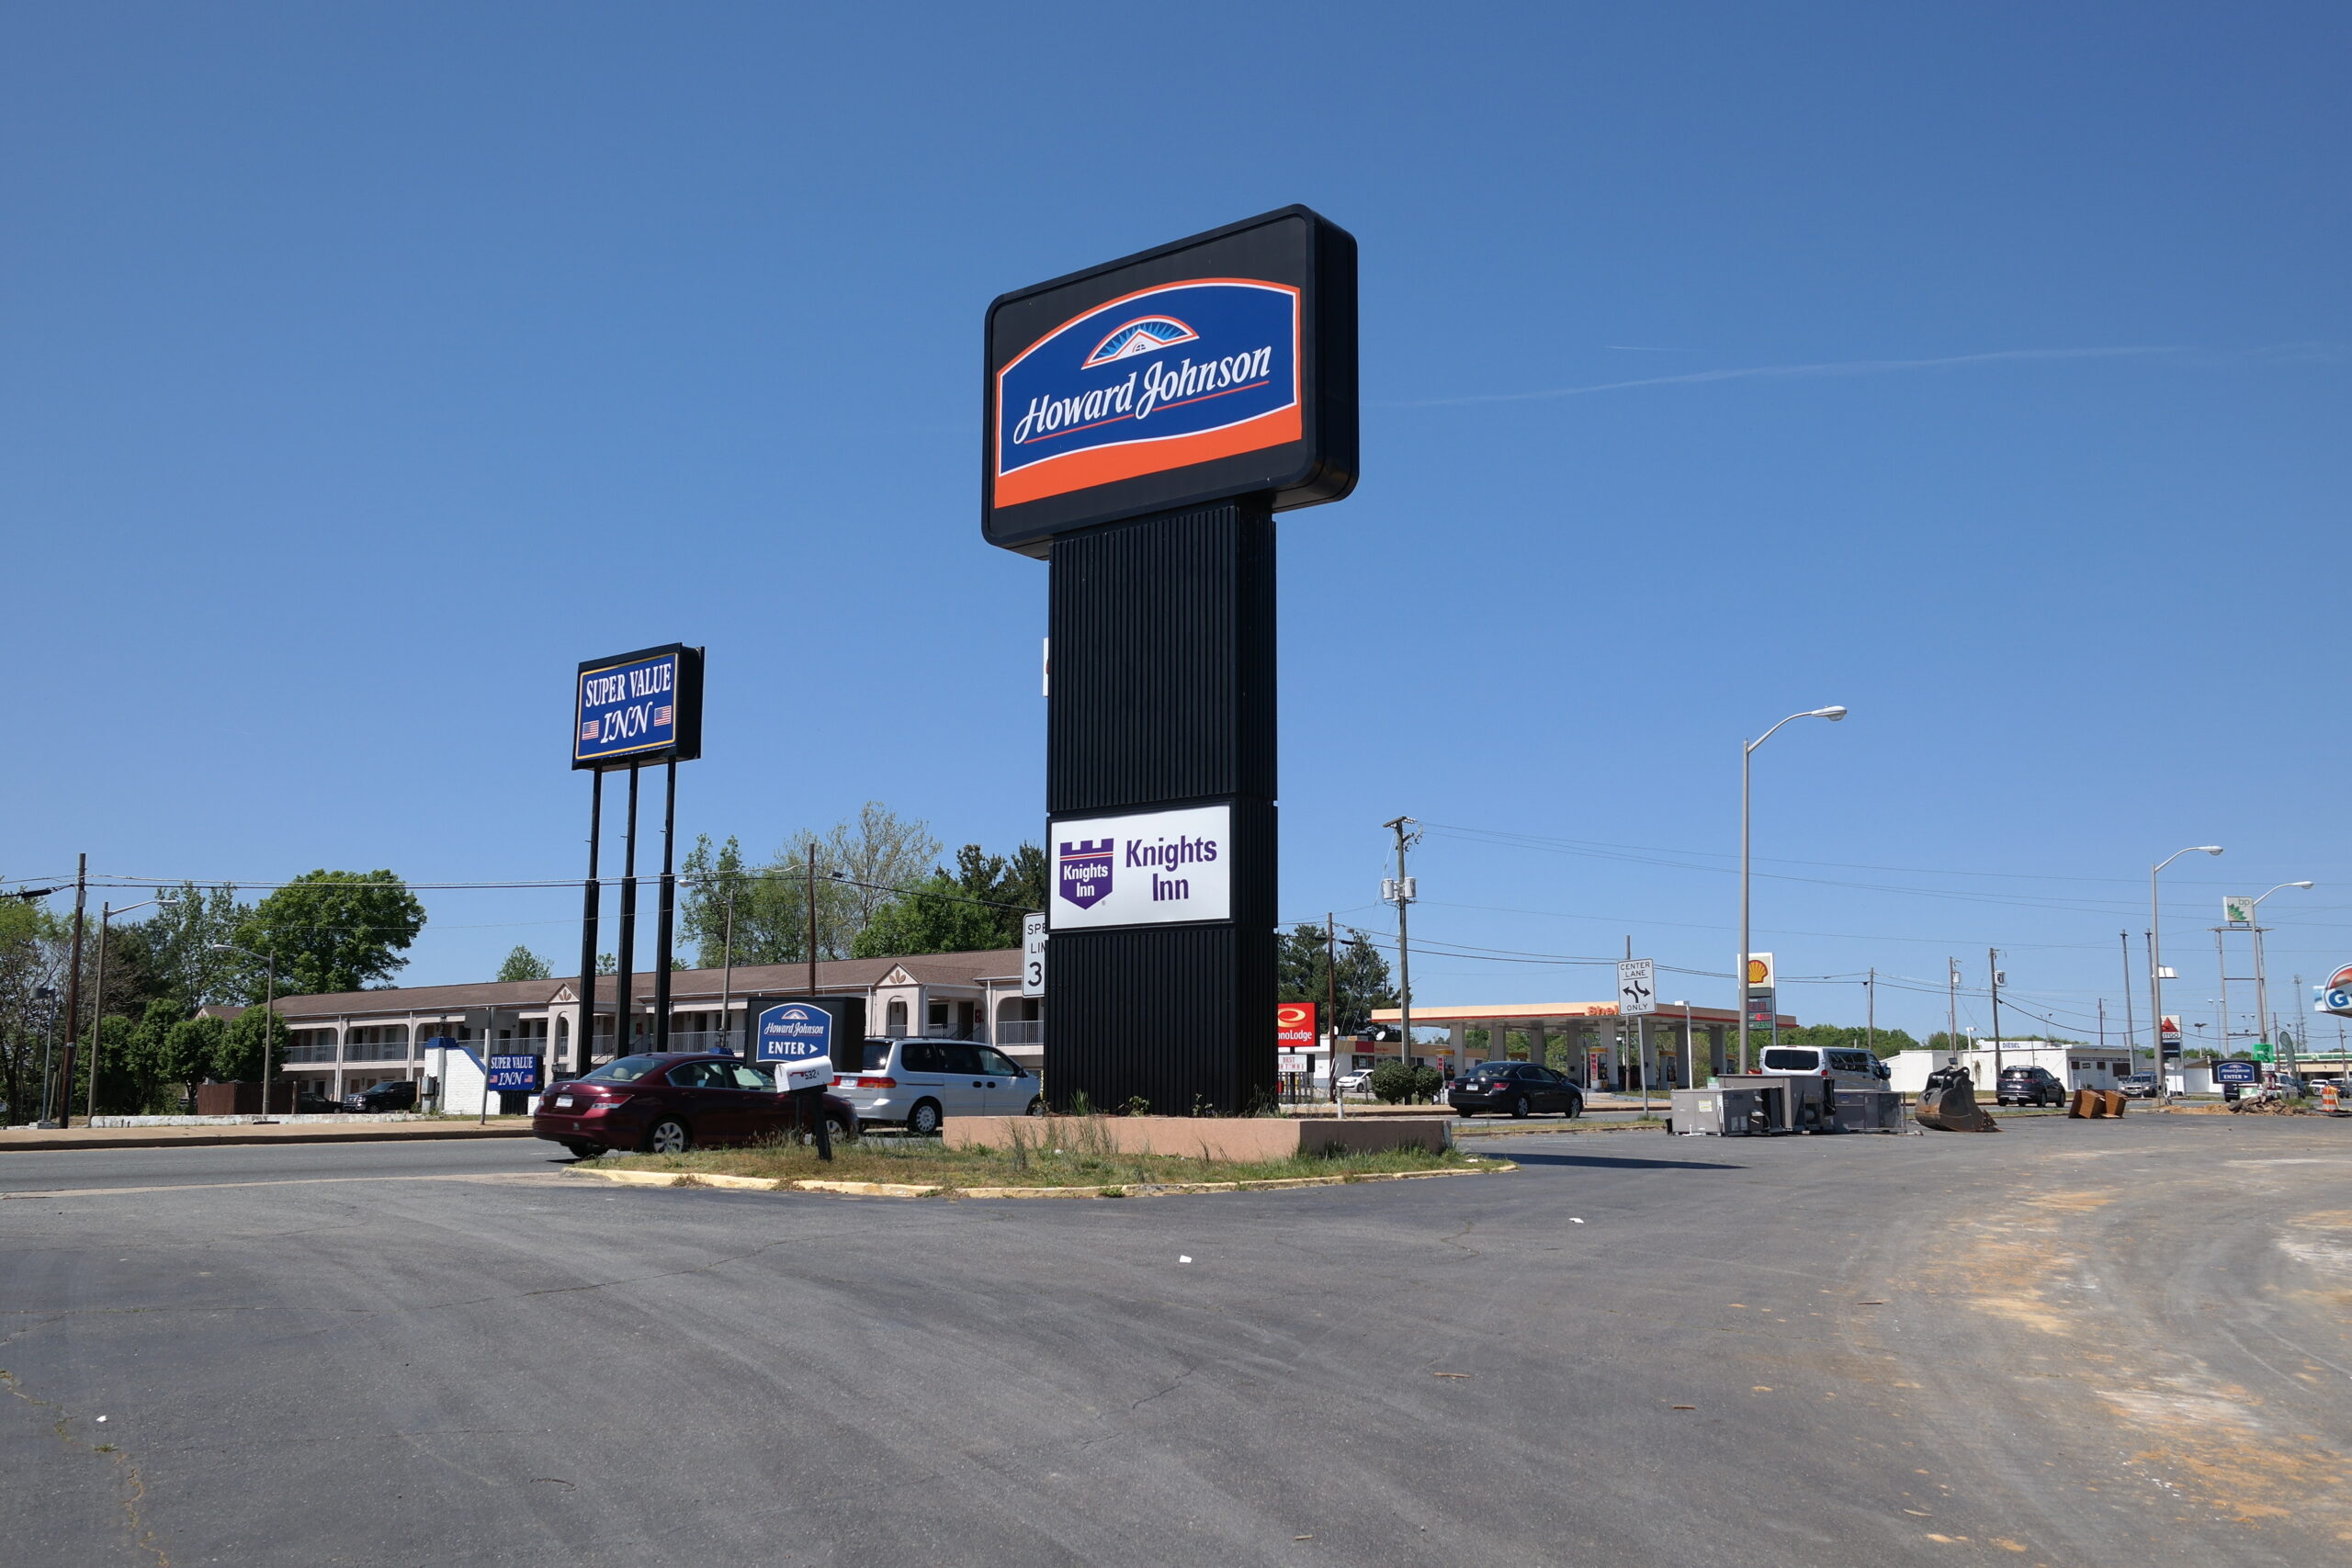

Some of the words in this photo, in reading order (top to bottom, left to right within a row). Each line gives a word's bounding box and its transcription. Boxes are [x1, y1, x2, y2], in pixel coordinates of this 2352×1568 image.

[1013, 371, 1137, 445] Howard
[1135, 345, 1272, 420] Johnson
[585, 673, 626, 708] SUPER
[629, 662, 672, 698] VALUE
[600, 701, 653, 743] INN
[1125, 835, 1217, 873] Knights
[1063, 863, 1109, 882] Knights
[1076, 883, 1095, 897] Inn
[1152, 874, 1189, 901] Inn
[2238, 897, 2250, 907] bp
[1027, 922, 1046, 935] SPE
[1620, 961, 1651, 971] CENTER
[1027, 961, 1043, 987] 3
[1625, 969, 1646, 978] LANE
[1588, 1005, 1620, 1015] Shel
[1626, 1003, 1648, 1011] ONLY
[763, 1021, 795, 1035] Howard
[792, 1021, 824, 1037] Johnson
[768, 1041, 806, 1055] ENTER
[491, 1056, 512, 1069] SUPER
[512, 1056, 533, 1069] VALUE
[498, 1071, 525, 1086] INN
